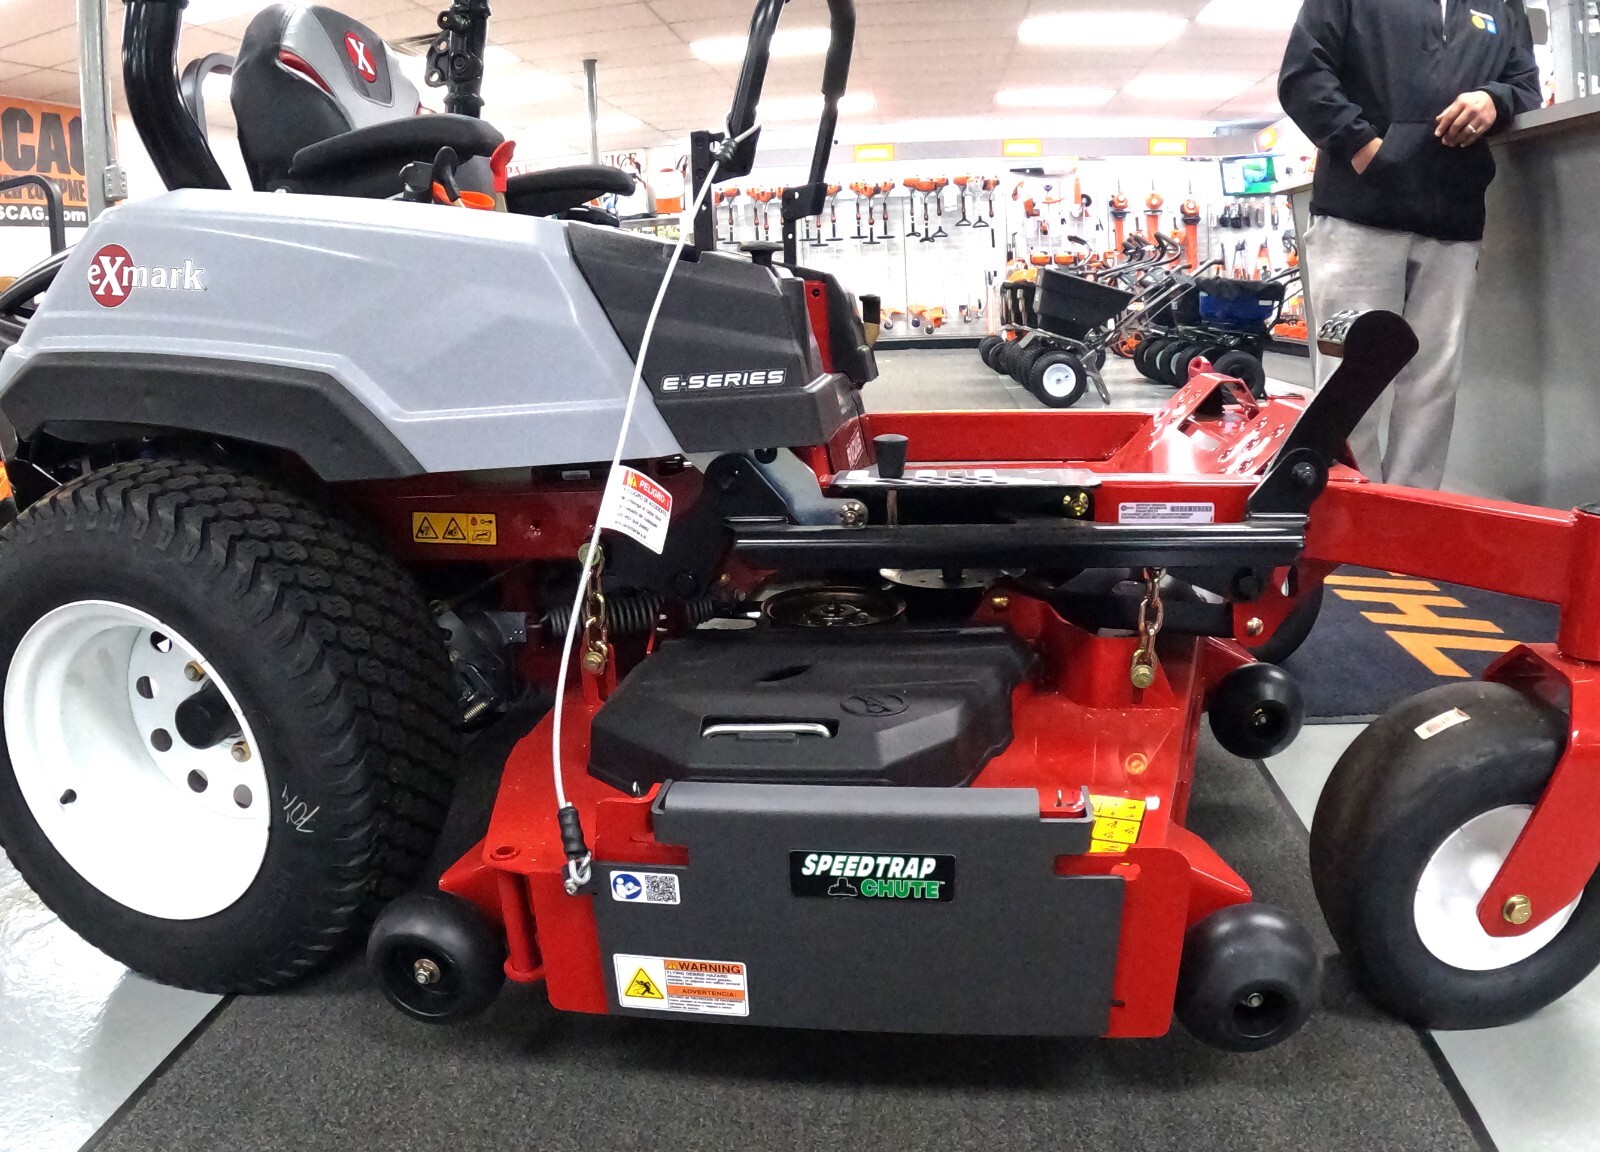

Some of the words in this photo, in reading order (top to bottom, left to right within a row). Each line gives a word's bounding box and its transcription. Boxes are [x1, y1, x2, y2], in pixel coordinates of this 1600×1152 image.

[347, 37, 375, 76] X
[87, 255, 204, 297] eXmark
[662, 370, 785, 391] E-SERIES
[639, 479, 665, 504] PELIGRO
[801, 853, 937, 879] SPEEDTRAP
[678, 962, 741, 974] WARNING
[682, 988, 737, 997] ADVERTENCIA:
